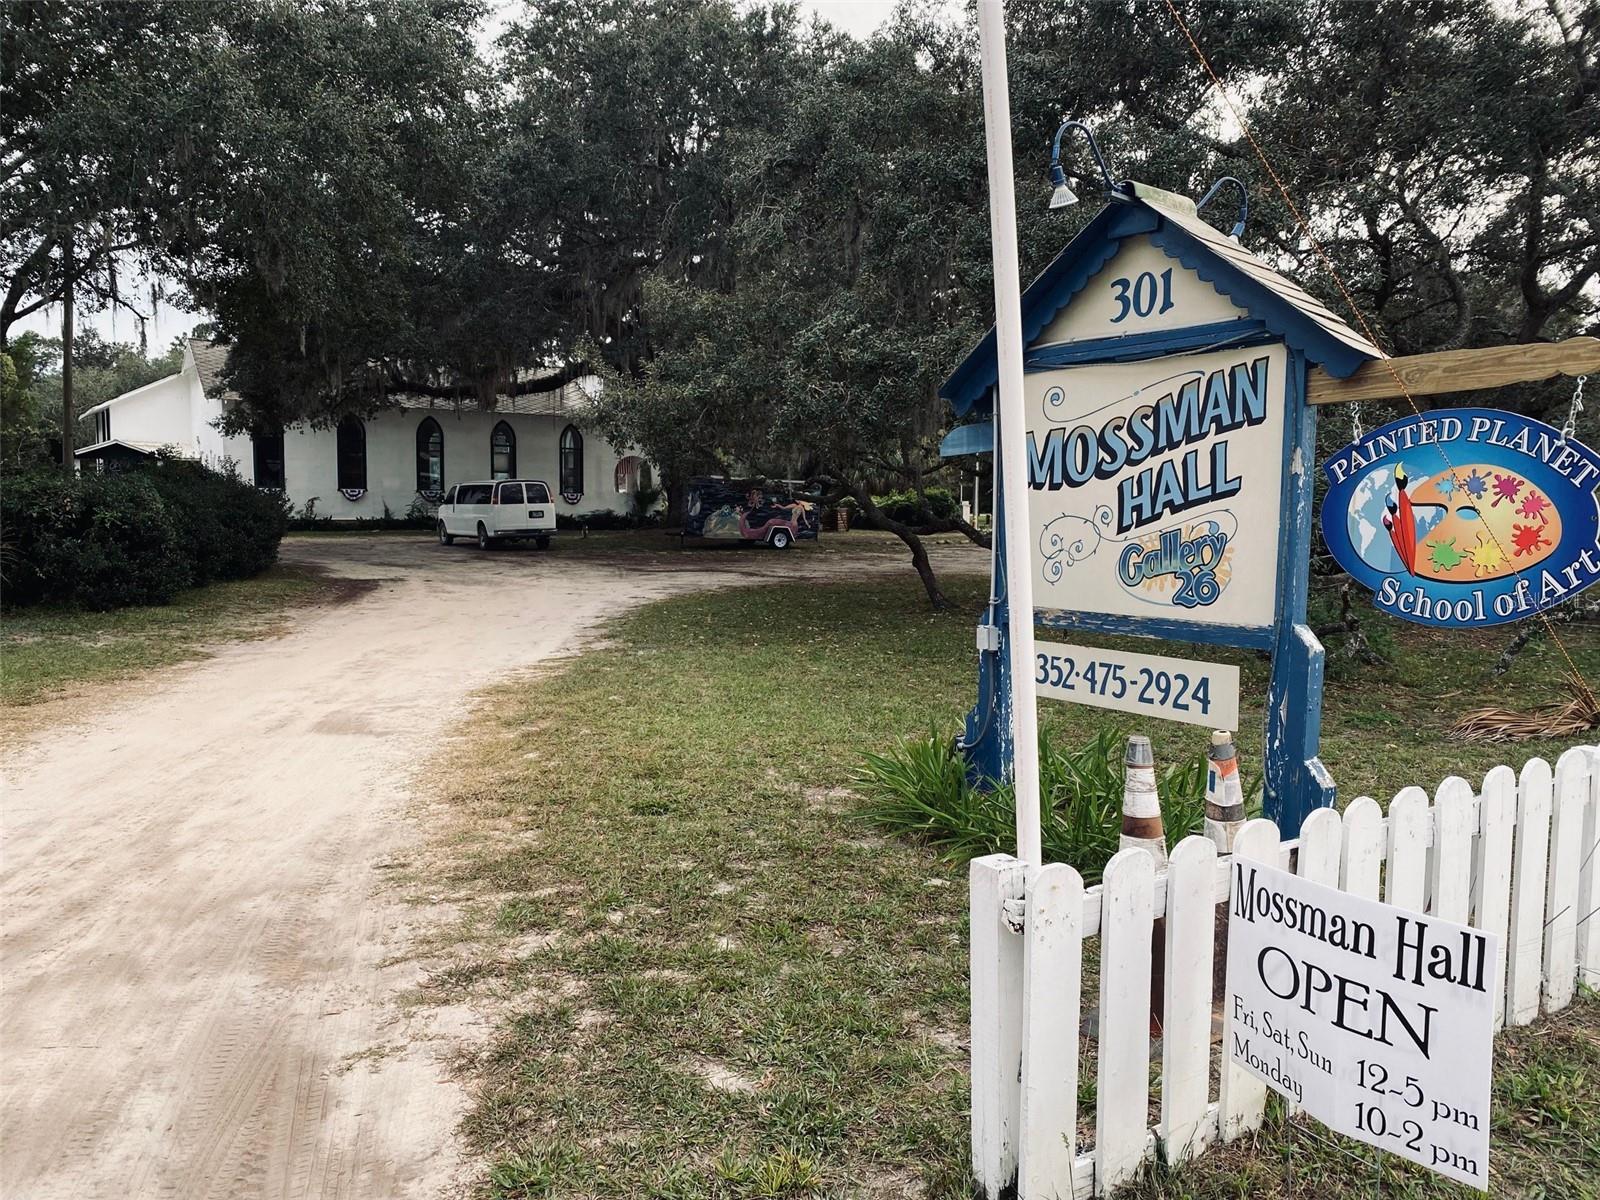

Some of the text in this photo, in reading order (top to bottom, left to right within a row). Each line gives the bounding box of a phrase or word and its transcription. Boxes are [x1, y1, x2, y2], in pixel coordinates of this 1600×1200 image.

[1110, 267, 1175, 323] 301
[1027, 356, 1270, 491] MOSSMAN
[1330, 417, 1600, 488] PAINTED PLANET
[1117, 440, 1242, 535] HALL
[1119, 528, 1228, 587] Gallery
[1172, 568, 1220, 608] 26
[1378, 547, 1600, 621] School of Art
[1234, 862, 1487, 992] Mossman Hall
[1257, 946, 1439, 1060] OPEN
[1233, 994, 1259, 1035] Fri,
[1263, 1011, 1294, 1054] Sat,
[1298, 1031, 1333, 1075] Sun
[1431, 1099, 1480, 1131] pm
[1233, 1032, 1303, 1104] Monday
[1429, 1143, 1479, 1176] pm
